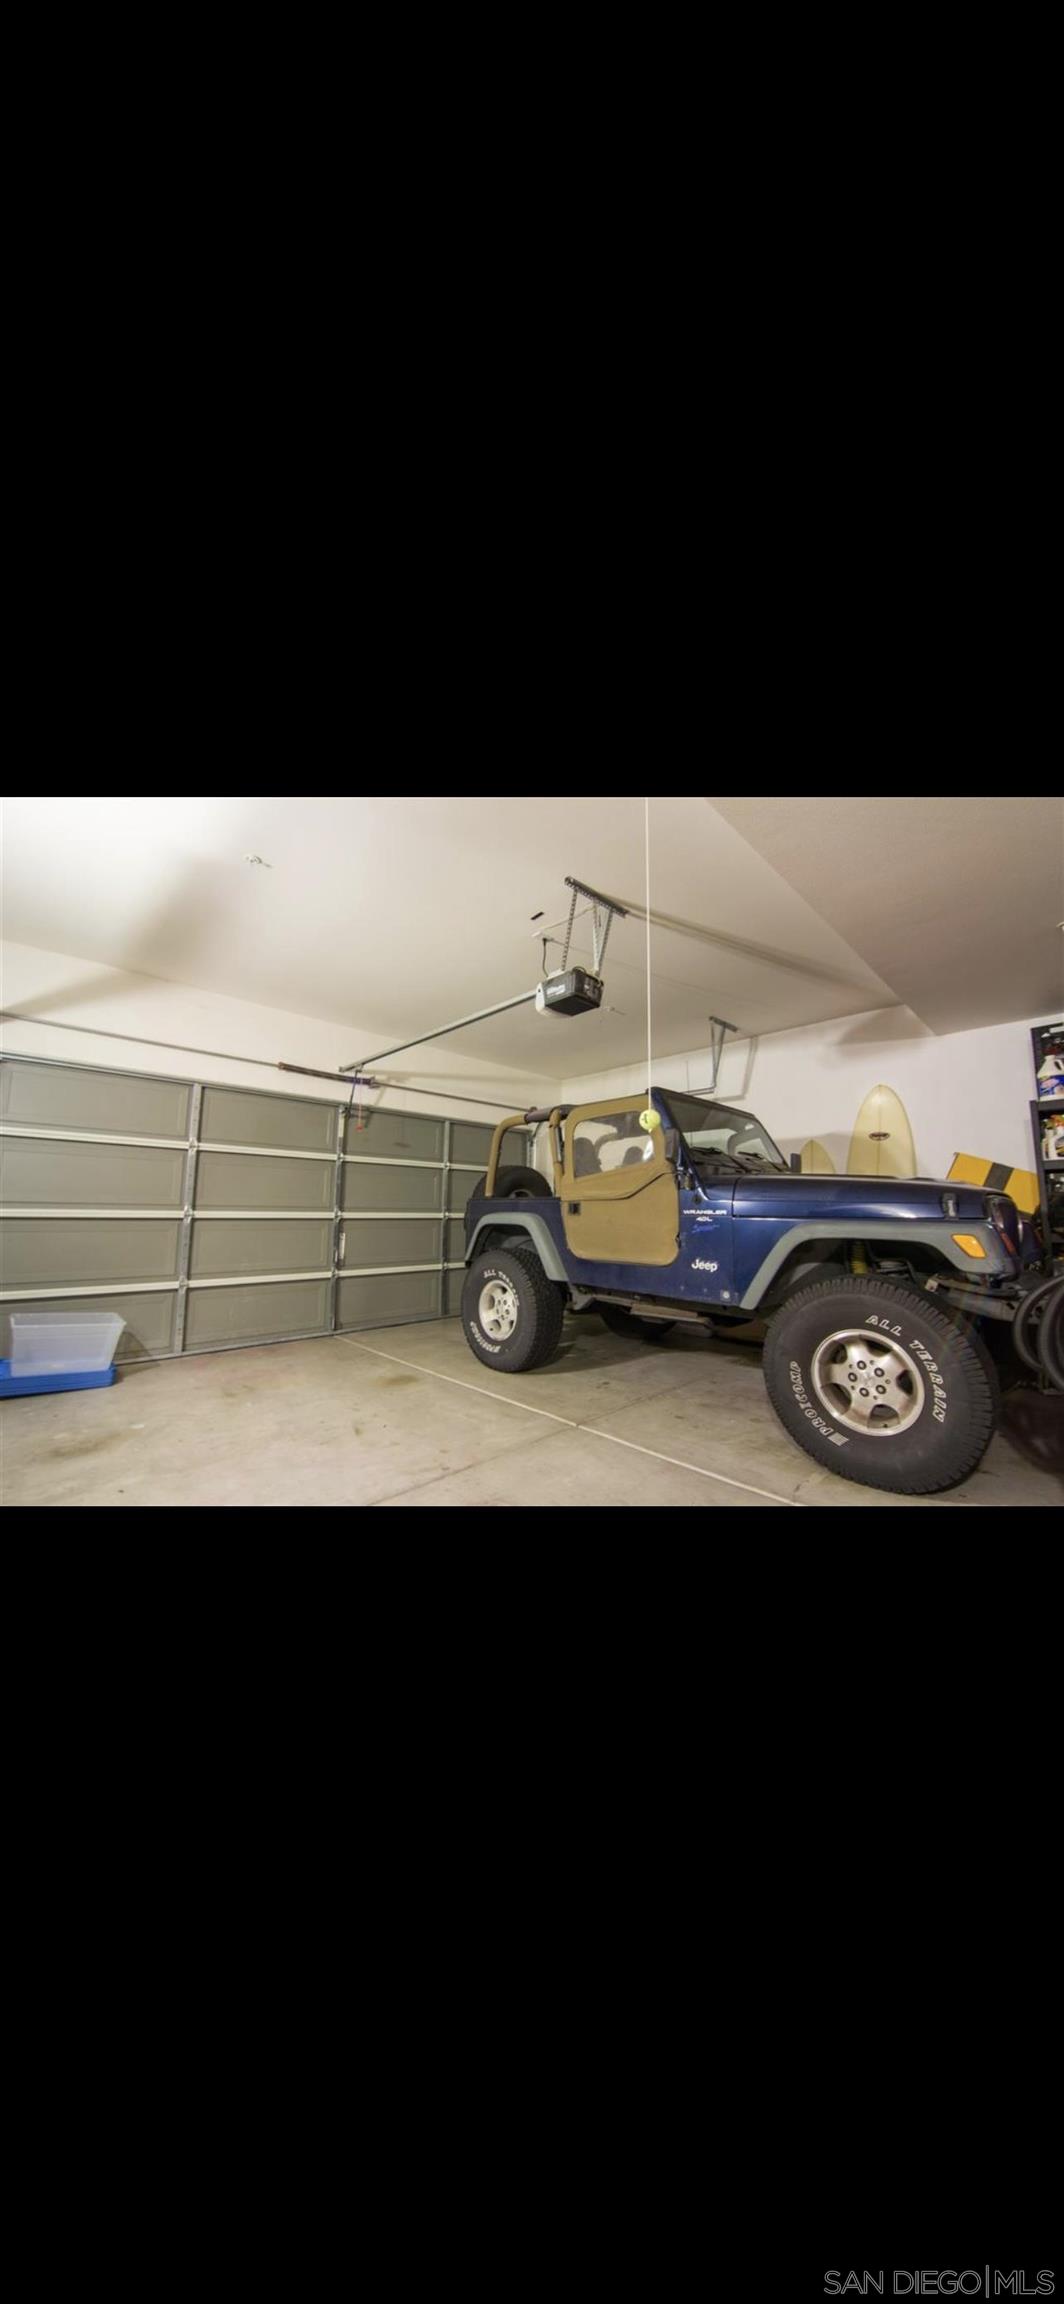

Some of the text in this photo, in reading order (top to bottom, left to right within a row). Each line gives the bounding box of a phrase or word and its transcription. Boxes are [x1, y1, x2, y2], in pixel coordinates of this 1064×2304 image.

[691, 1258, 718, 1272] Jeep
[864, 1314, 948, 1424] ALL TERRAIN
